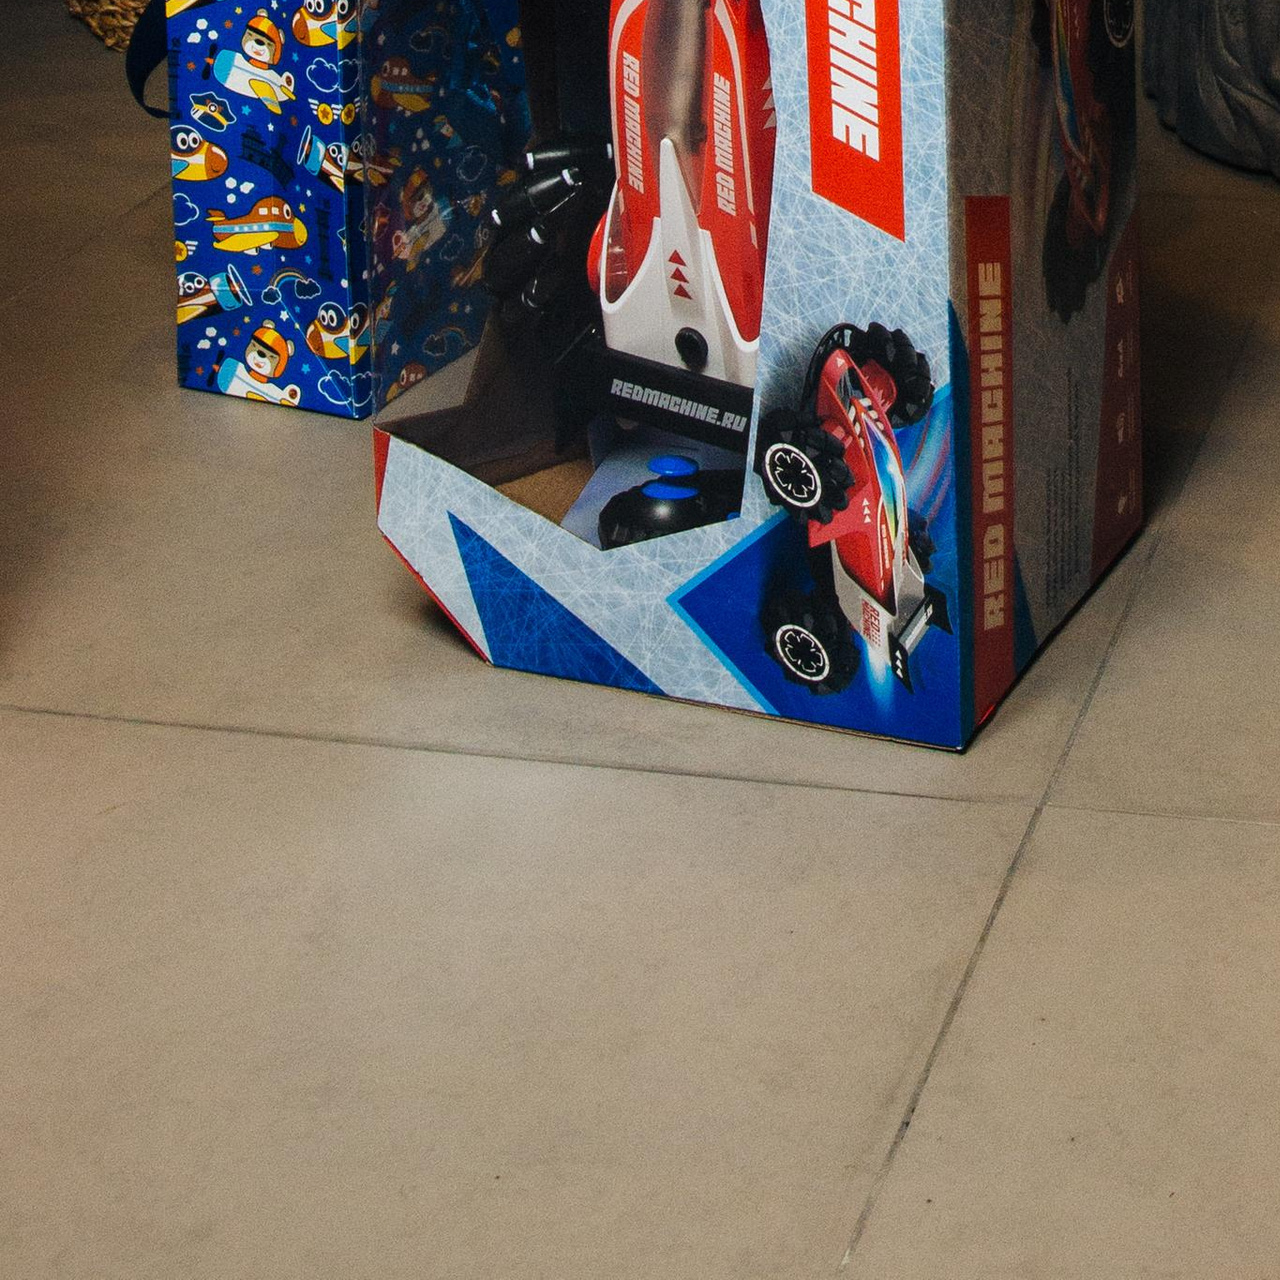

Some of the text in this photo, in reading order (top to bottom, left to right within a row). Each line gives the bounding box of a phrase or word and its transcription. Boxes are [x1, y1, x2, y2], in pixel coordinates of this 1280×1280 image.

[622, 50, 645, 195] RED MACHINE
[713, 71, 737, 217] RED MACHINE
[610, 378, 748, 433] REDMACHINE.RU
[978, 261, 1005, 632] RED MACHINE
